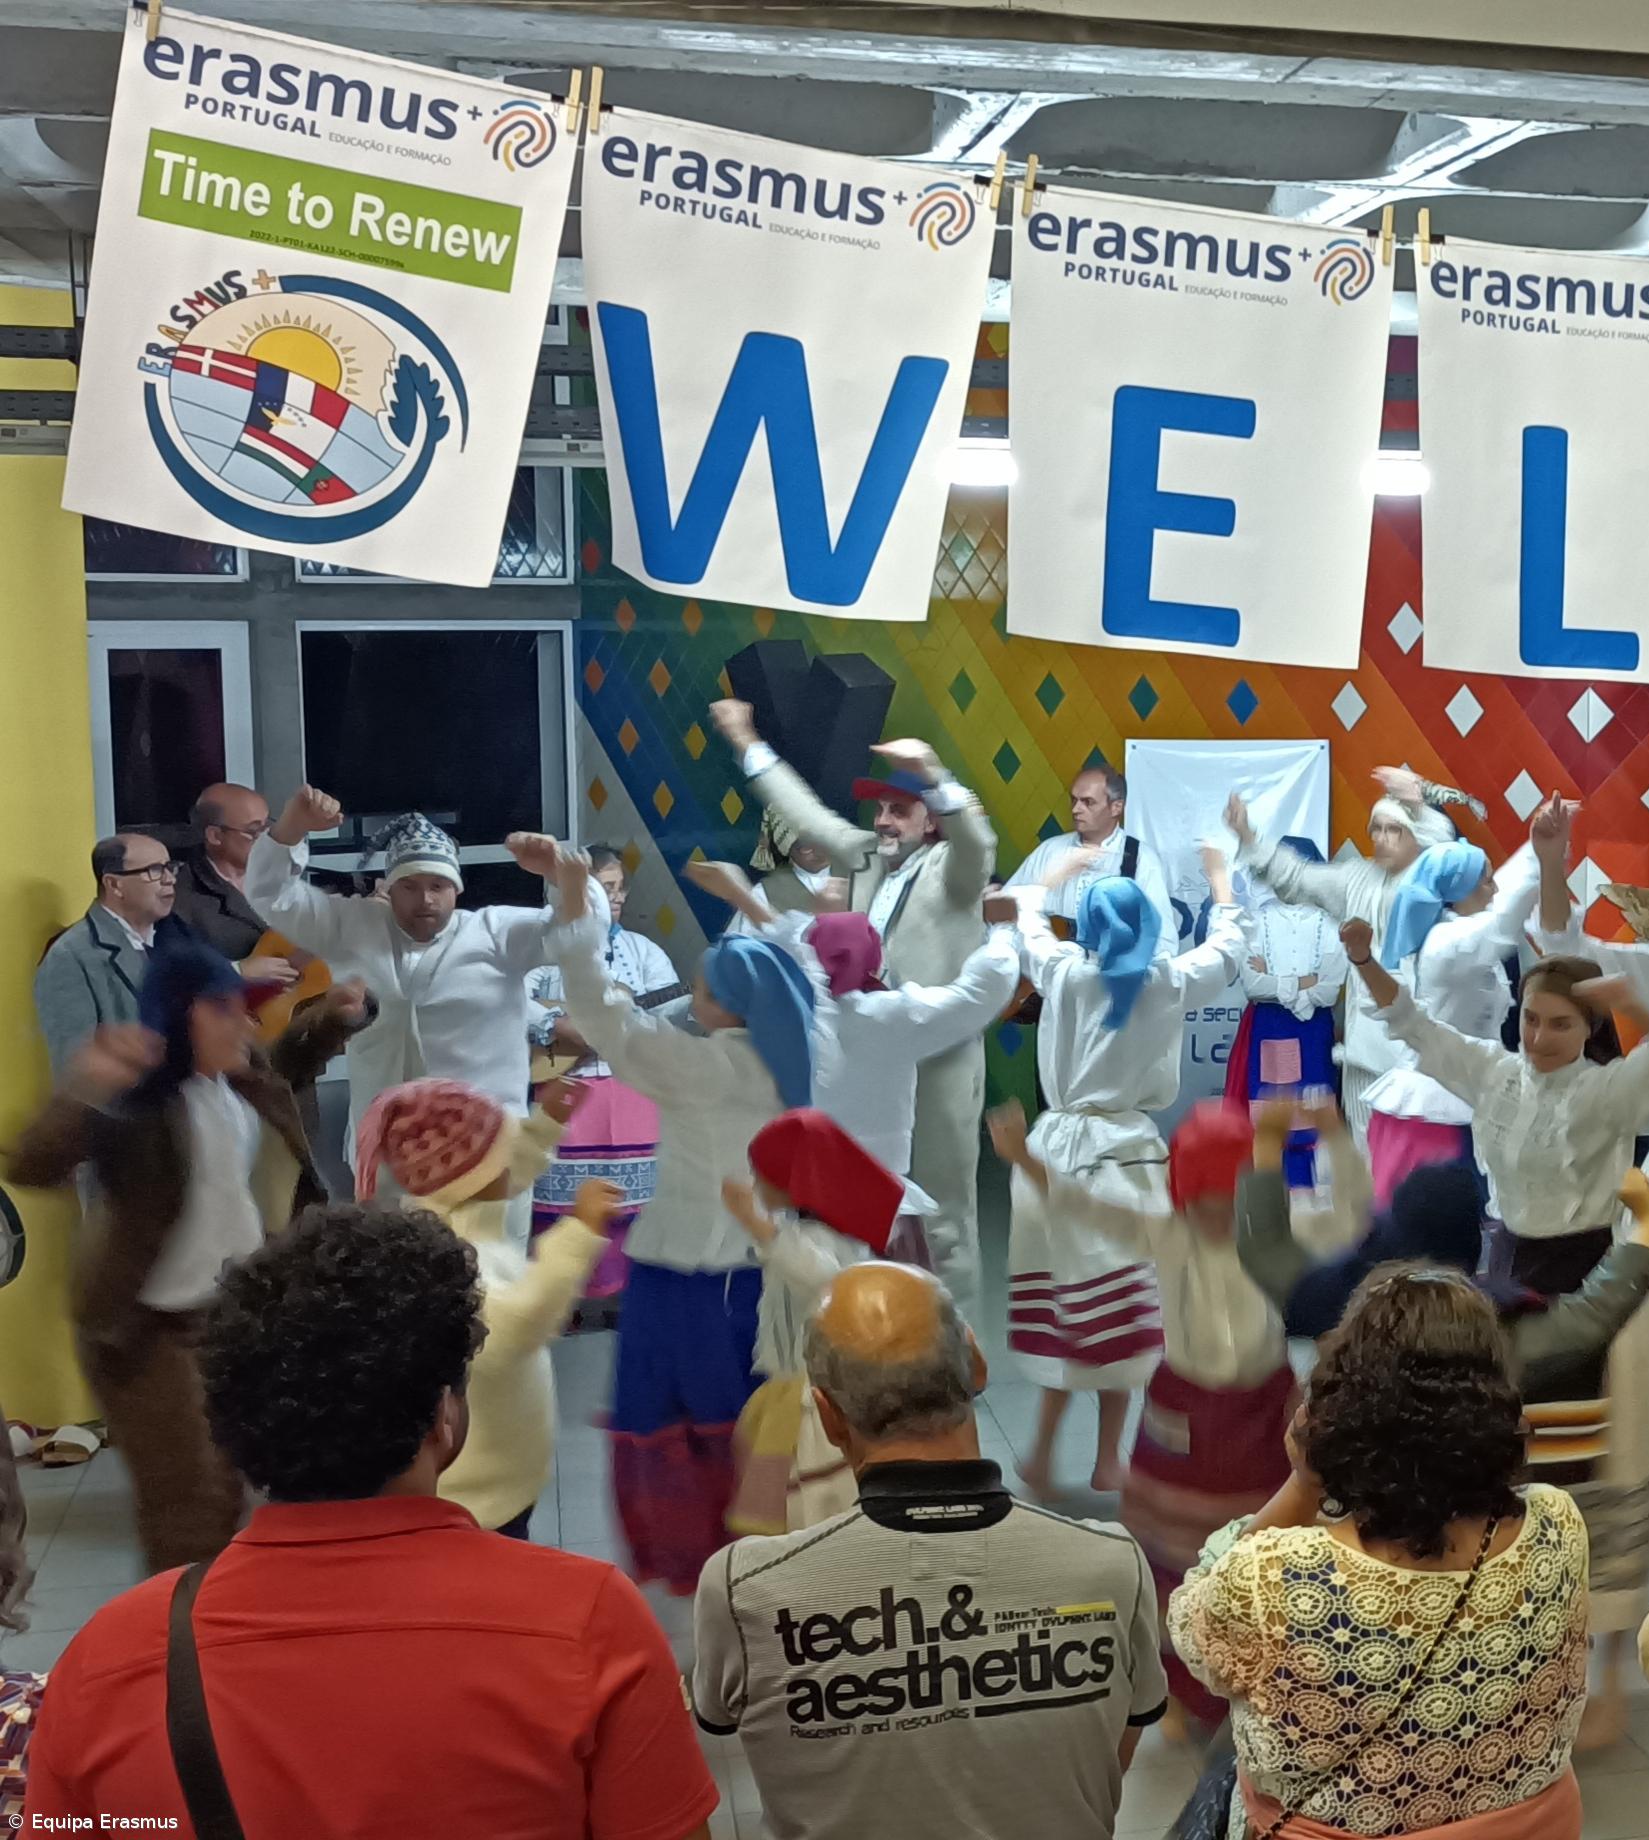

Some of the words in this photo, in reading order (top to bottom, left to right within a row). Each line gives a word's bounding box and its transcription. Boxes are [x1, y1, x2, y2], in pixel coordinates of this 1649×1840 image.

[184, 93, 321, 138] PORTUGAL
[328, 132, 385, 154] EDUCAÇÃO
[386, 144, 393, 154] E
[394, 146, 452, 166] FORMAÇÃO
[154, 149, 271, 217] Time
[287, 181, 334, 230] to
[349, 191, 512, 267] Renew
[639, 190, 762, 229] PORTUGAL
[769, 223, 820, 242] EDUCAÇÃO
[821, 232, 827, 242] E
[828, 234, 880, 251] FORMAÇÃO
[1064, 262, 1178, 292] PORTUGAL
[1184, 284, 1231, 301] EDUCAÇÃO
[1233, 290, 1238, 298] E
[1240, 292, 1288, 306] FORMAÇÃO
[1461, 308, 1560, 334] PORTUGAL
[598, 303, 951, 608] W
[1102, 384, 1258, 648] E
[1518, 424, 1642, 673] L
[786, 1629, 1115, 1725] aesthetics
[790, 1722, 856, 1739] Research
[861, 1718, 890, 1735] and
[896, 1707, 970, 1731] resources
